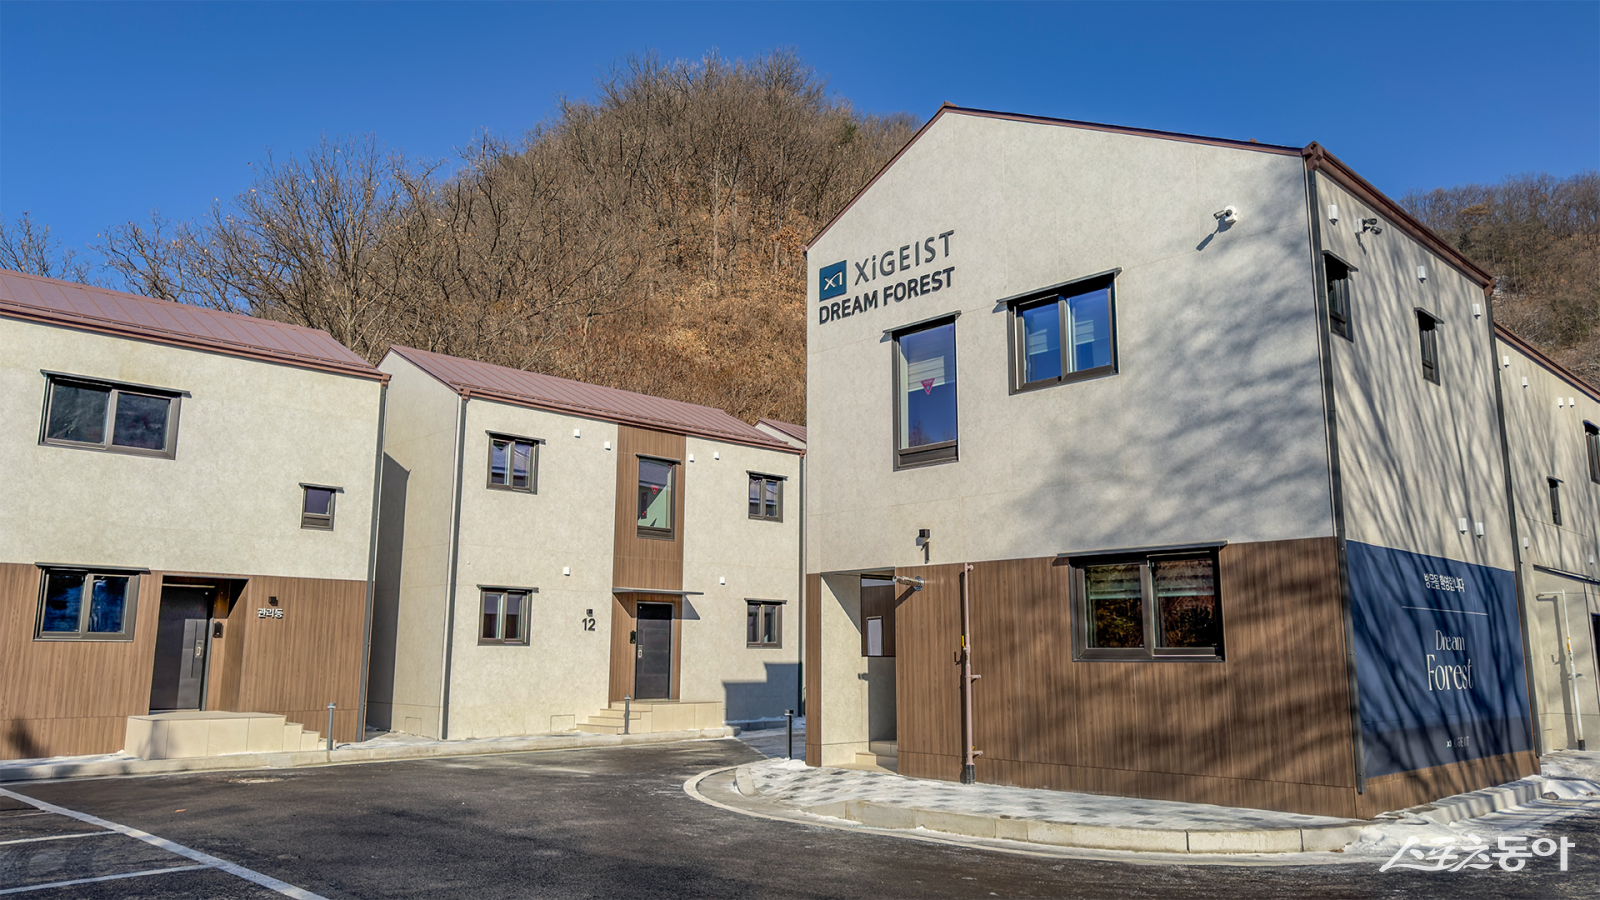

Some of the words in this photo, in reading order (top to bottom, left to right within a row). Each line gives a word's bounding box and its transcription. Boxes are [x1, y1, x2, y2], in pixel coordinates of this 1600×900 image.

[854, 229, 955, 286] XiGEIST
[819, 290, 878, 325] DREAM
[883, 266, 956, 306] FOREST
[257, 607, 284, 619] 관리동
[581, 617, 596, 631] 12
[1435, 630, 1465, 651] Dream
[1426, 654, 1473, 691] Forest
